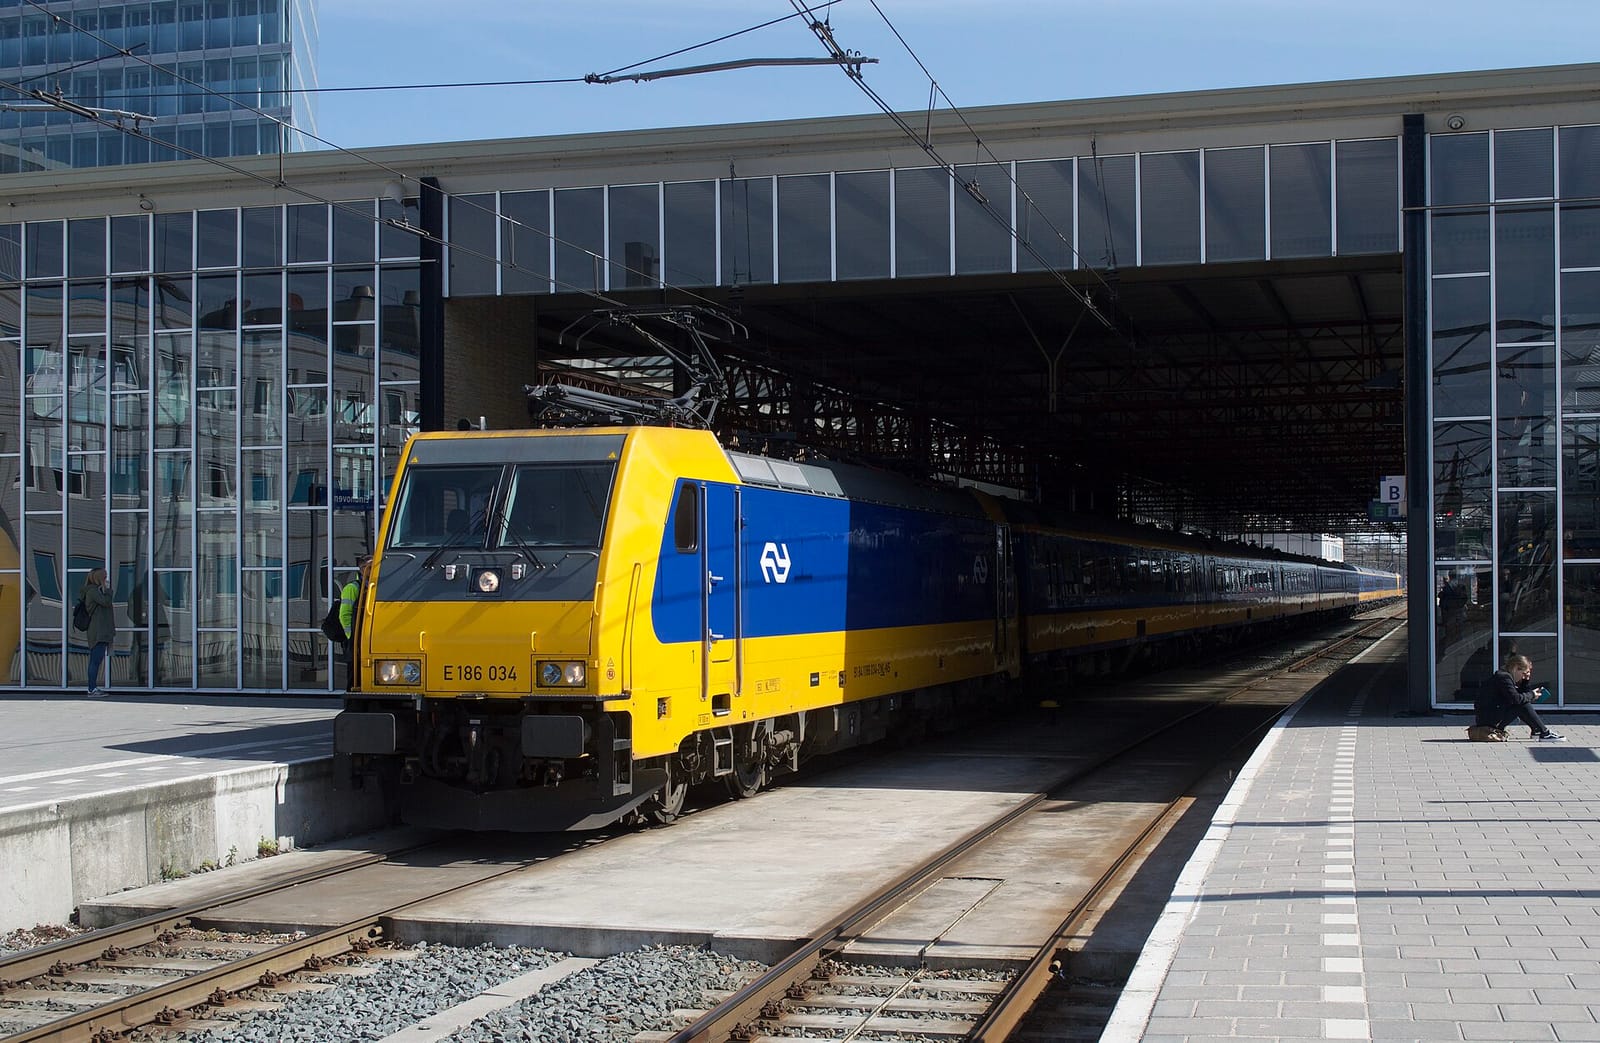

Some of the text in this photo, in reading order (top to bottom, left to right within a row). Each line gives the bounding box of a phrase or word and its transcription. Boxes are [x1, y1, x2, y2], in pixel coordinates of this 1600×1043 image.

[1389, 485, 1400, 500] B
[443, 665, 517, 681] E 186 034
